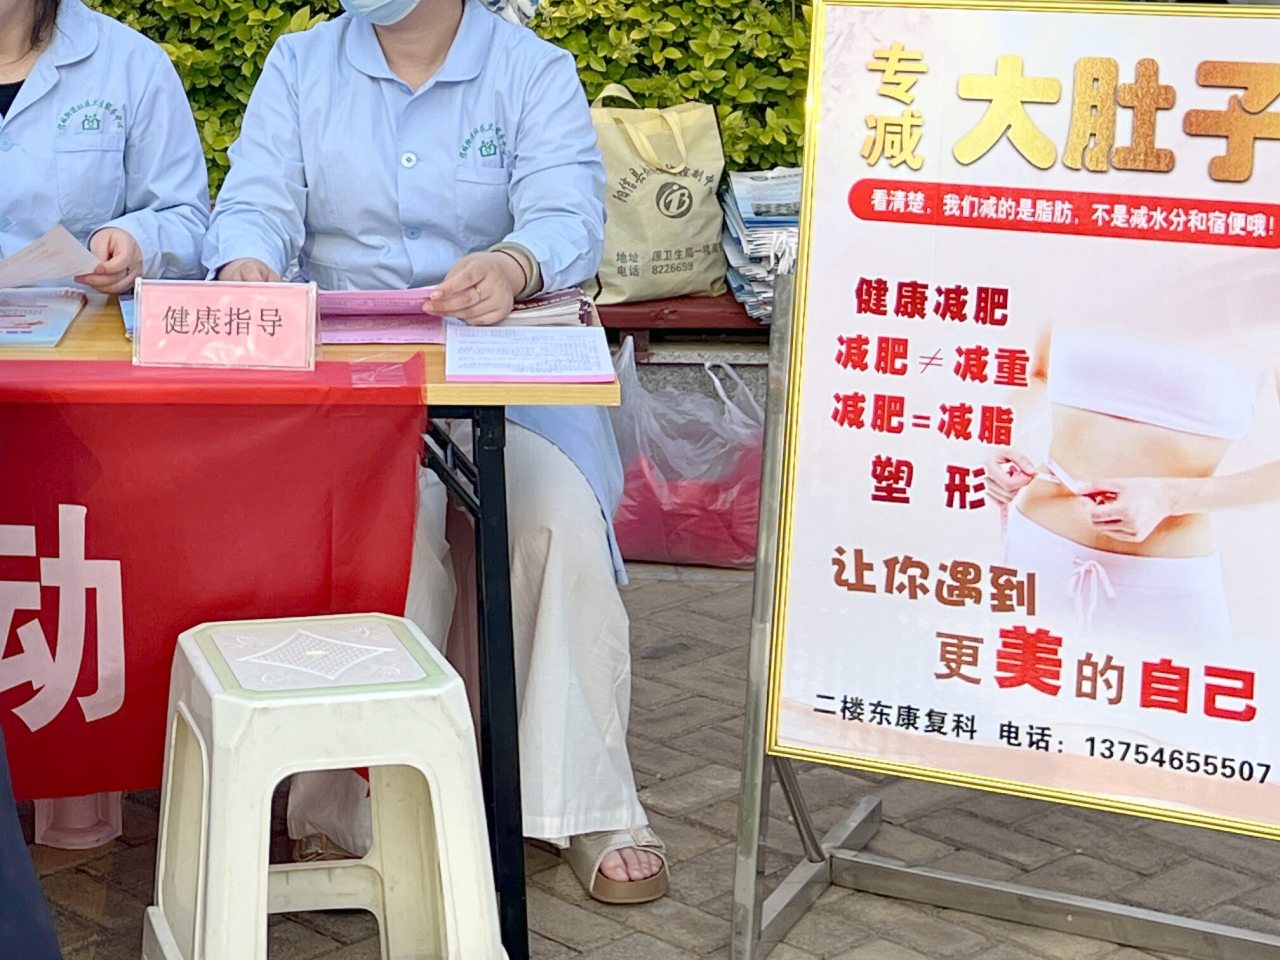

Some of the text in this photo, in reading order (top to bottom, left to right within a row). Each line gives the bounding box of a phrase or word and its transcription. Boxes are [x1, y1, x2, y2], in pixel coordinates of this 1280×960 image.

[952, 54, 1280, 183] 大肚子
[161, 304, 284, 338] 健康指导
[854, 276, 1010, 327] 健康减肥
[830, 545, 1037, 617] 让你遇到
[933, 625, 1258, 723] 更美的自己
[812, 692, 978, 741] 二楼东康复科
